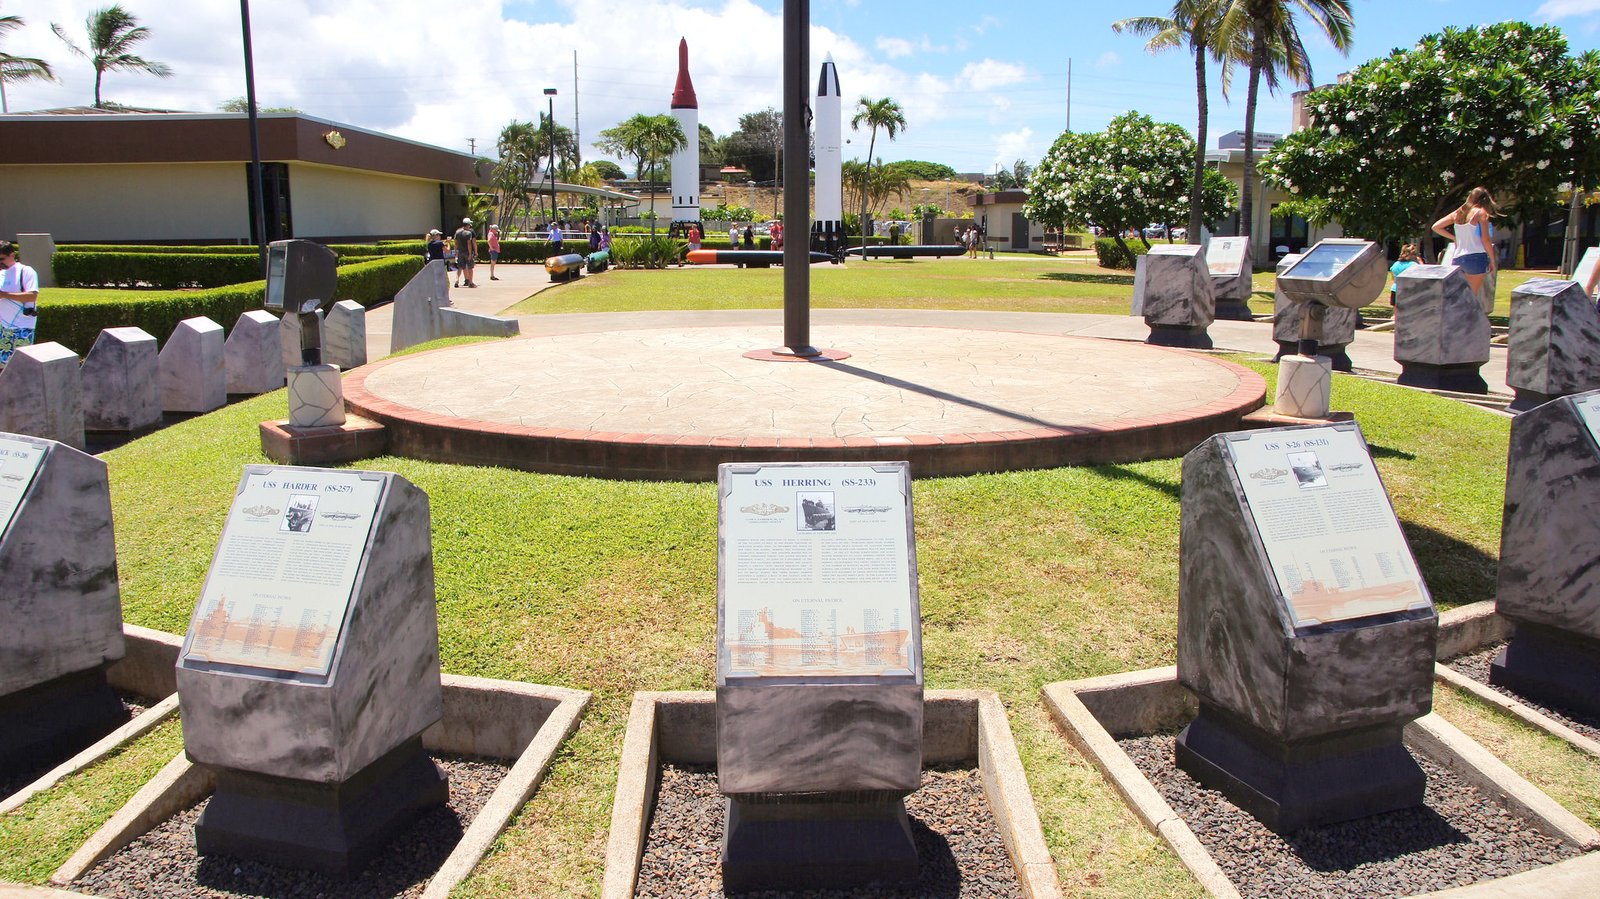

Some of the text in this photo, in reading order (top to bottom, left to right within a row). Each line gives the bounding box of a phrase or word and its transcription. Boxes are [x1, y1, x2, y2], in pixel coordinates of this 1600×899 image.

[1264, 442, 1280, 450] USS
[1303, 438, 1330, 447] (SS-131)
[282, 482, 318, 491] HARDER
[324, 484, 353, 494] (SS-257)
[754, 478, 876, 487] USS HERRING (SS-233)
